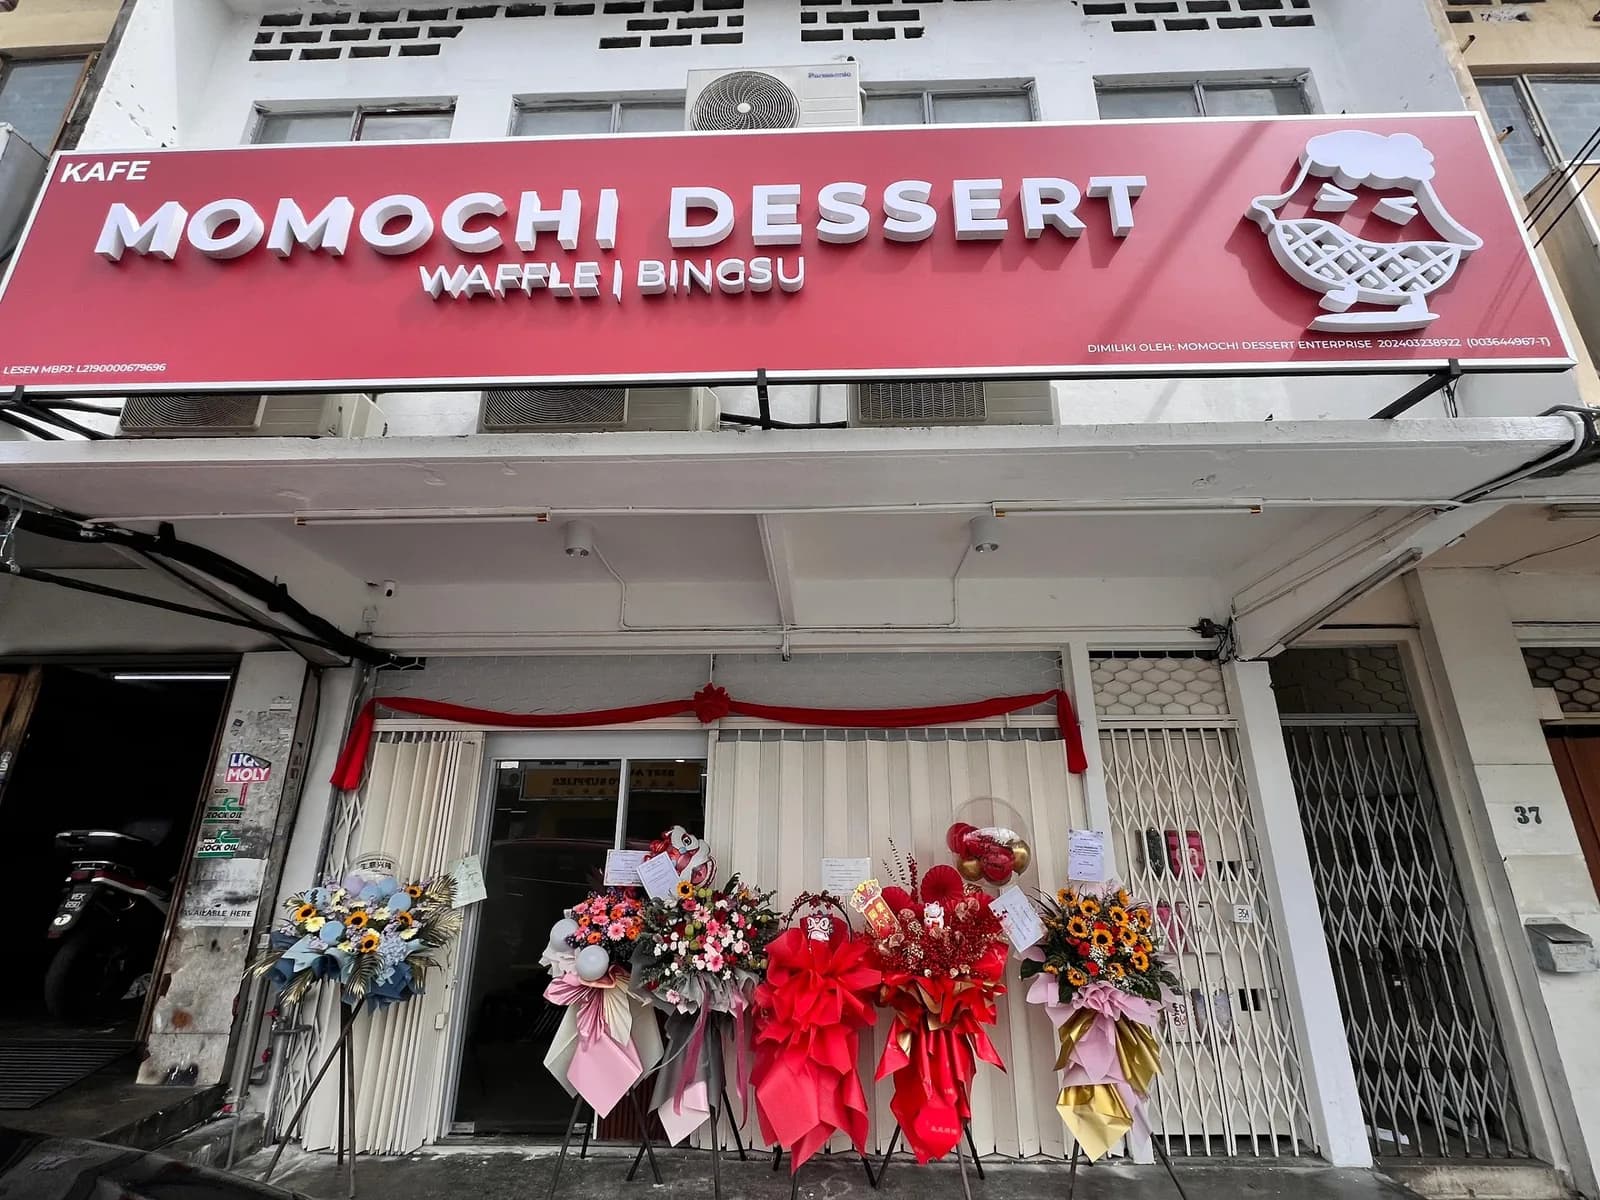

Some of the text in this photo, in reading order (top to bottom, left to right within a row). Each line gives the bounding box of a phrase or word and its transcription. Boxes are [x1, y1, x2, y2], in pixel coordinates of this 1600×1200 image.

[60, 160, 151, 183] KAFE
[94, 175, 1147, 262] MOMOCHI DESSERT
[419, 261, 601, 299] WAFFLE
[636, 256, 805, 295] BINGSU
[1087, 344, 1137, 353] DIMILIKI
[1139, 343, 1176, 352] OLEH:
[1177, 342, 1239, 351] MOMOCHI
[1242, 341, 1296, 350] DESSERT
[1298, 339, 1373, 349] ENTERPRISE
[1377, 338, 1462, 348] 202403238922
[3, 363, 167, 375] LESEN MBPJ: L2190000679696
[230, 754, 260, 767] LIQ
[227, 767, 270, 781] MOLY
[1514, 805, 1543, 825] 37
